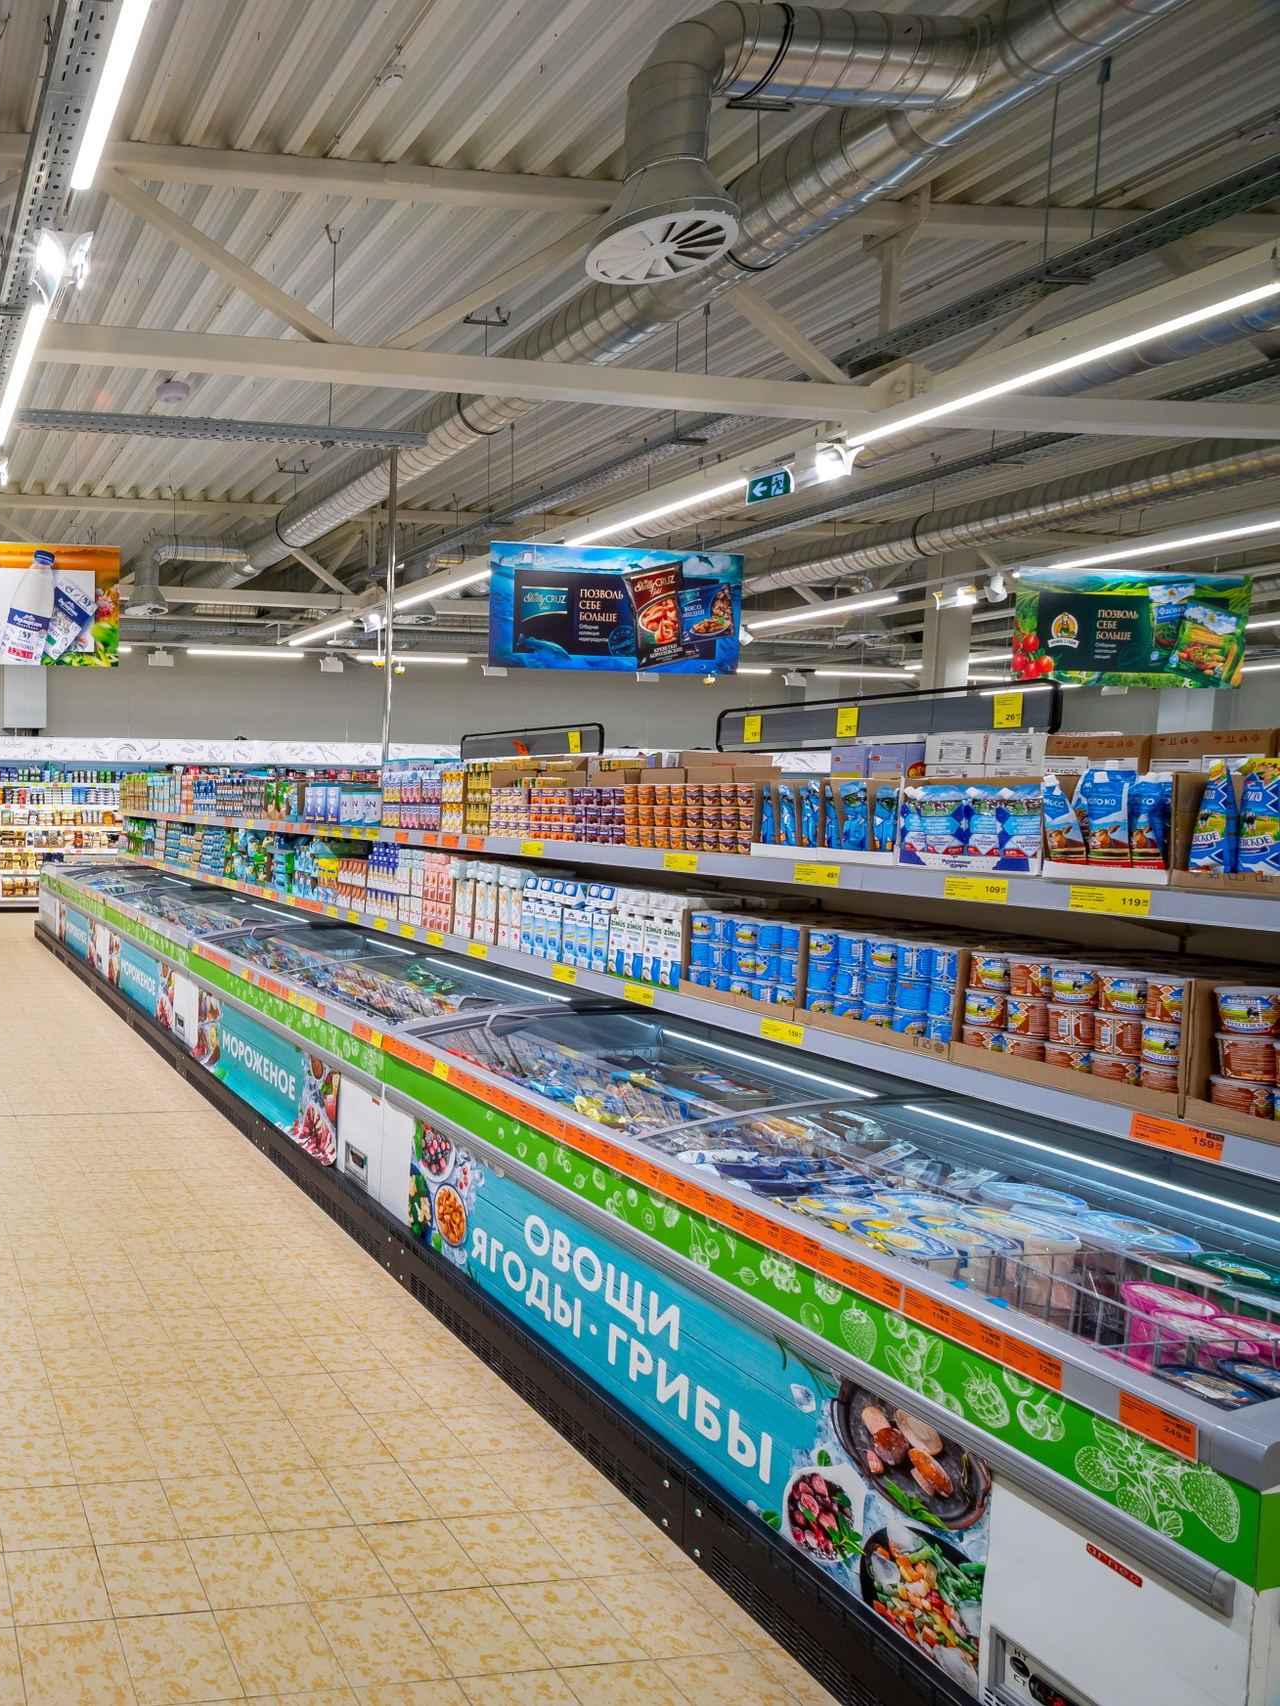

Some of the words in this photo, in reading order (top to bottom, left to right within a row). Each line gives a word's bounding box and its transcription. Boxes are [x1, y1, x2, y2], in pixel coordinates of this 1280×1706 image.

[655, 574, 676, 585] CRUZ
[545, 594, 566, 604] CRUZ
[580, 589, 623, 599] ПОЗВОЛЬ
[579, 601, 601, 610] СЕБЕ
[684, 604, 702, 612] МЯСО
[579, 612, 617, 622] БОЛЬШЕ
[1098, 609, 1139, 619] ПОЗВОЛЬ
[1096, 620, 1117, 629] СЕБЕ
[1096, 631, 1132, 641] БОЛЬШЕ
[11, 640, 34, 651] МОЛОКО
[1005, 713, 1016, 721] 26
[1121, 898, 1141, 907] 119
[66, 919, 88, 946] МОРОЖЕНОЕ
[121, 959, 156, 998] МОРОЖЕНОЕ
[222, 1030, 296, 1101] МОРОЖЕНОЕ
[1192, 1137, 1214, 1149] 159
[524, 1214, 680, 1350] ОВОЩИ
[981, 1335, 994, 1347] 129
[471, 1227, 582, 1338] ЯГОДЫ
[607, 1323, 773, 1485] ГРИБЫ
[1039, 1364, 1053, 1376] 129
[1164, 1425, 1182, 1440] 249
